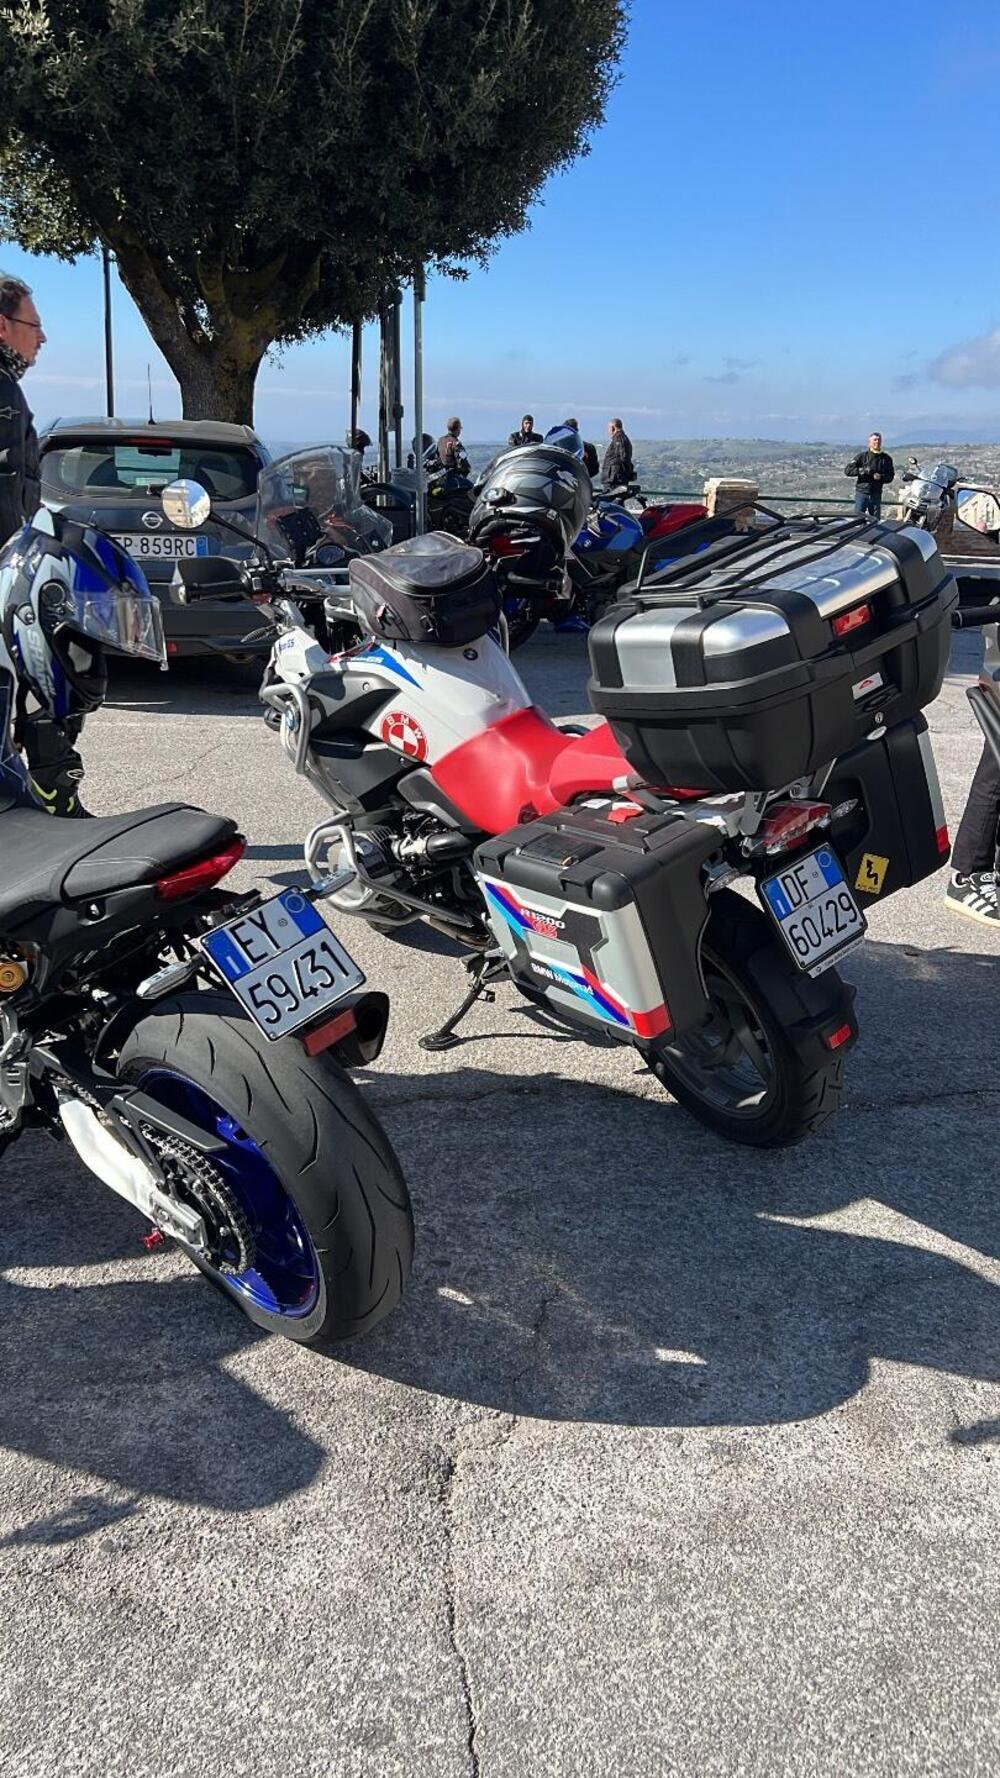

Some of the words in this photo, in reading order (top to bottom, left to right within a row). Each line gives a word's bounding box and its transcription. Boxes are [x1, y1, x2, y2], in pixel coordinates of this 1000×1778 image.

[140, 537, 195, 556] 859RC
[386, 714, 423, 739] BMW
[781, 866, 809, 908] DF
[228, 911, 281, 964] EY
[520, 908, 566, 929] R1200
[788, 892, 858, 956] 60429
[248, 941, 350, 1025] 59431
